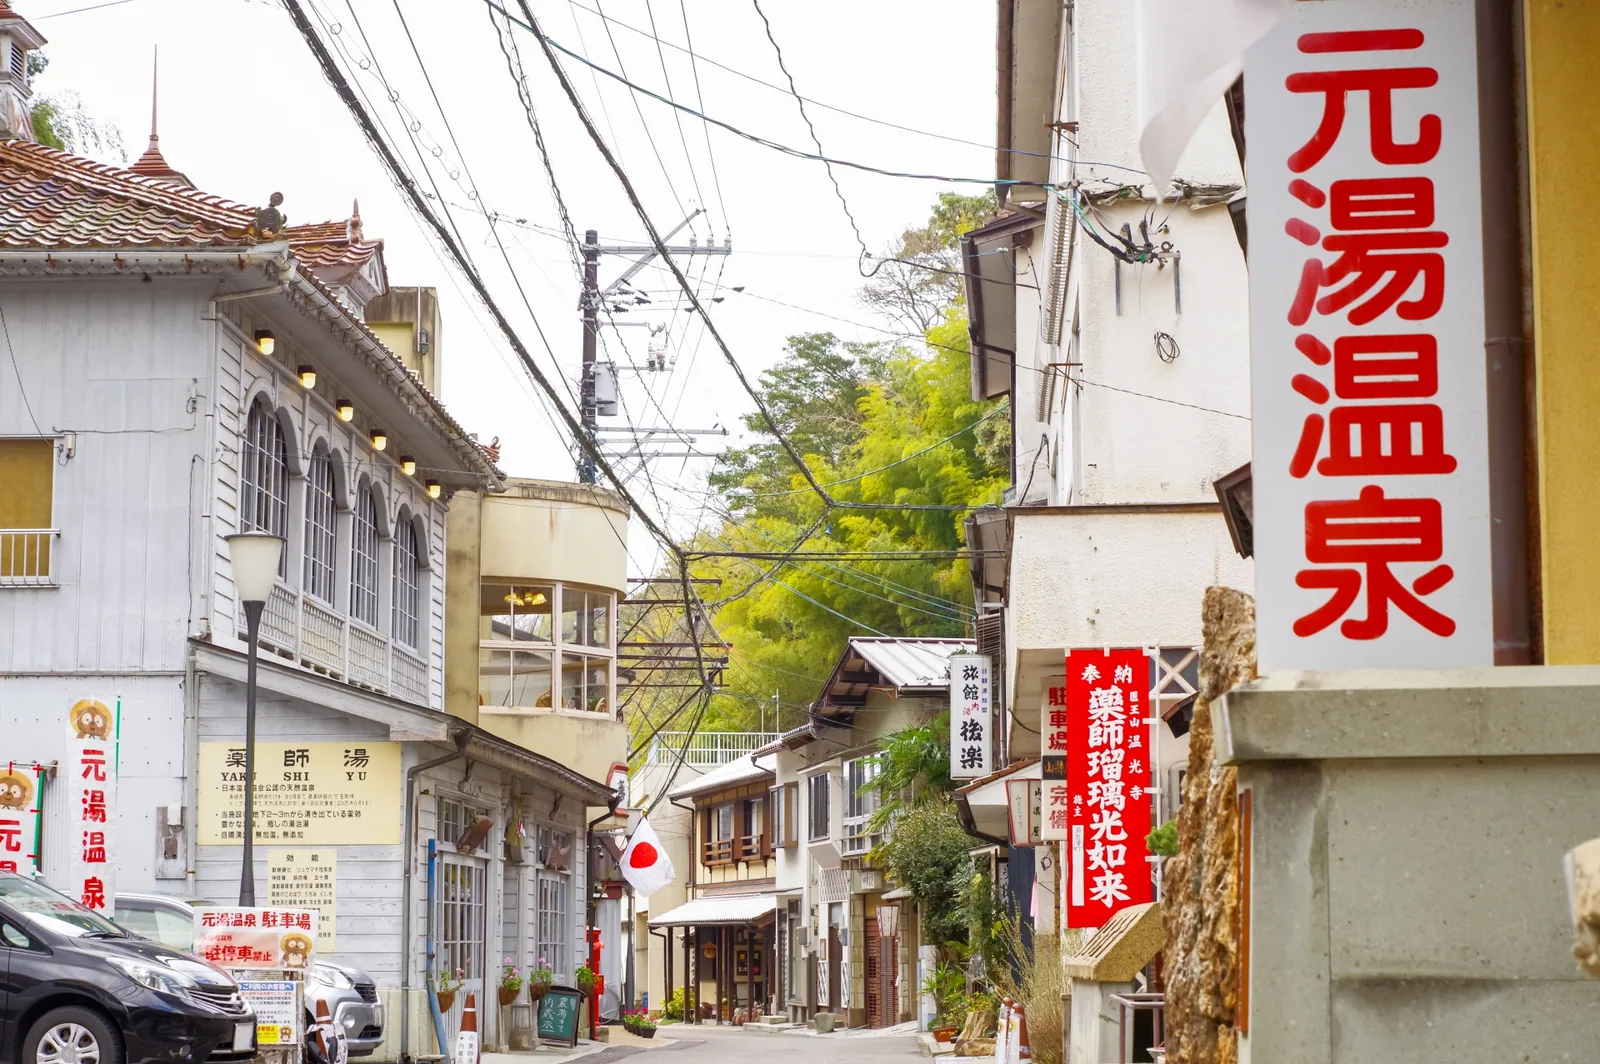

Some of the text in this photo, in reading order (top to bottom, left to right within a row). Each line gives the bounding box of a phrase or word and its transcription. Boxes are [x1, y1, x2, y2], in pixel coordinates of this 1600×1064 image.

[1284, 27, 1458, 641] 元湯温泉
[1081, 663, 1133, 684] 奉納
[960, 664, 983, 769] 旅館 後楽
[1048, 687, 1067, 750] 駐車場
[221, 784, 315, 792] 日本温協会公認の天然温泉
[283, 772, 309, 781] SHI
[81, 749, 106, 909] 元湯温泉
[202, 912, 257, 927] 元湯温泉
[262, 911, 311, 930] 駐車場
